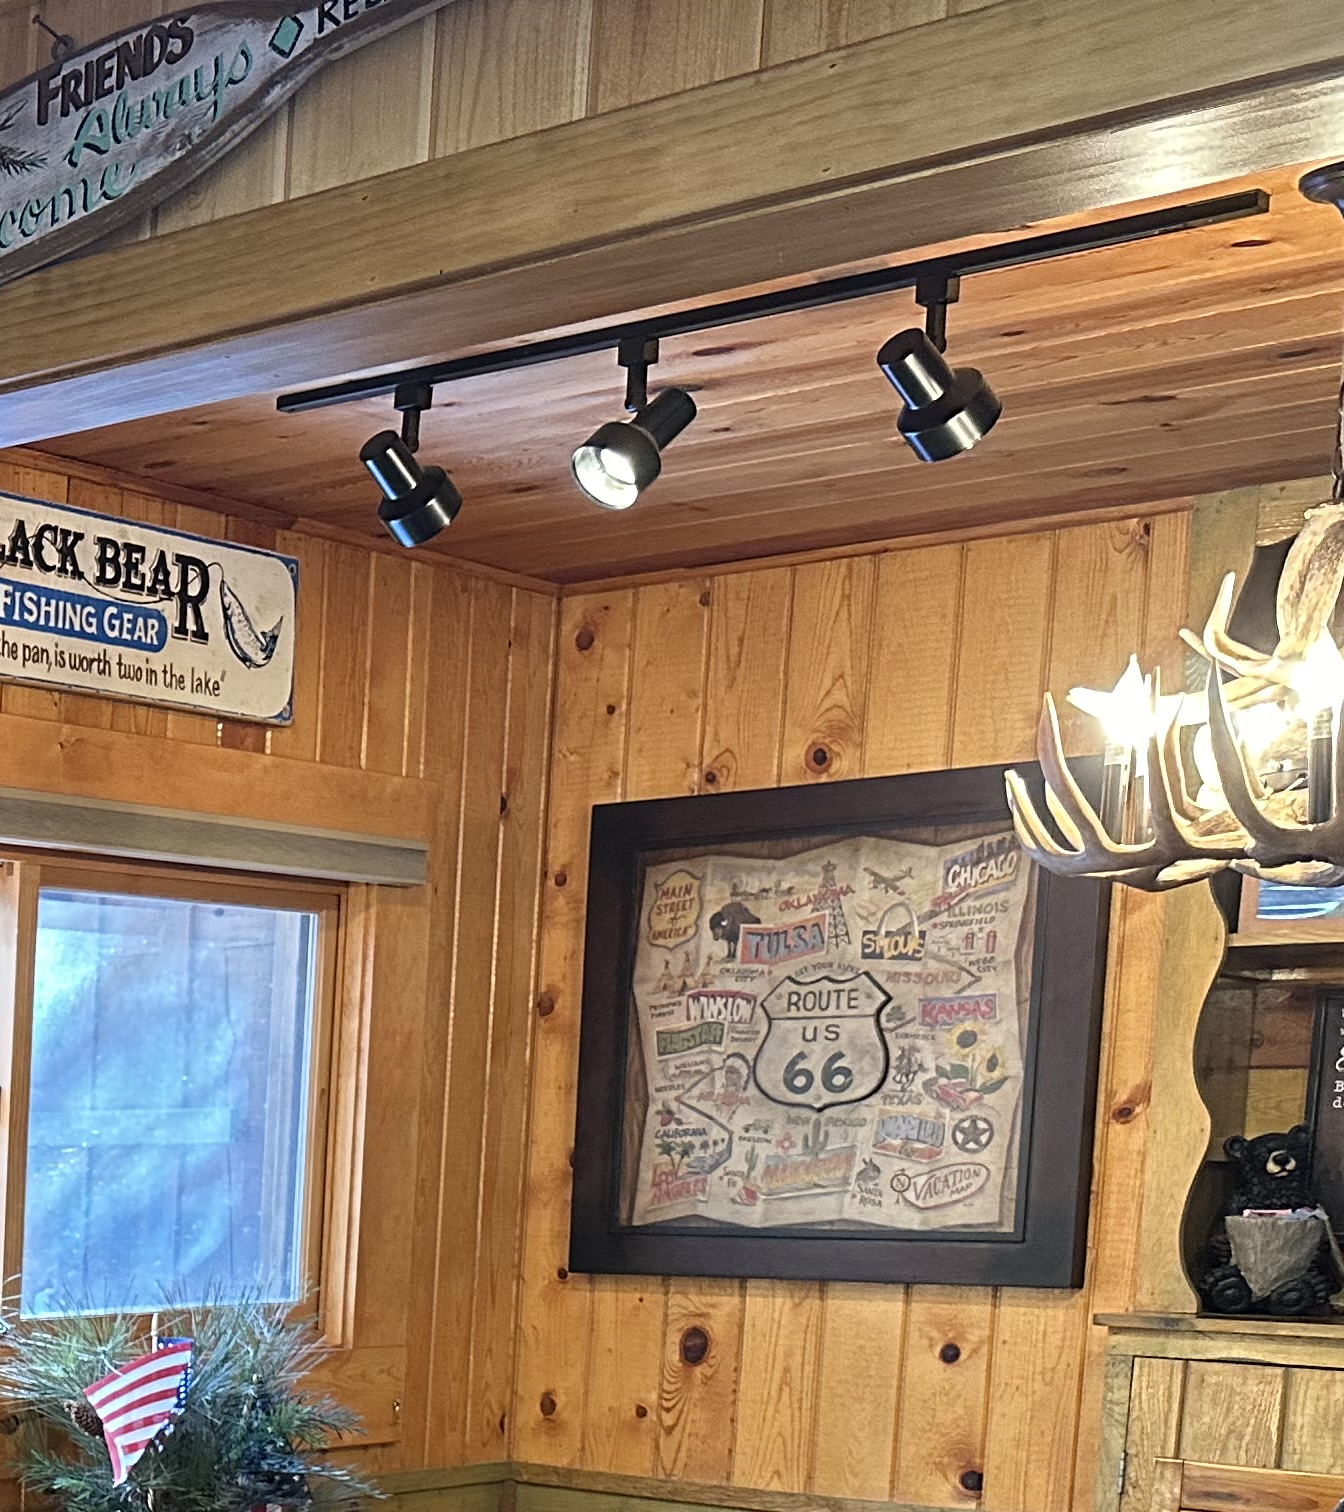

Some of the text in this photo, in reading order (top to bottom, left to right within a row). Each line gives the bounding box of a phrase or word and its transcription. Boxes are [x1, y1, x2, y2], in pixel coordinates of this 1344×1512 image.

[37, 17, 196, 126] FRIENDS
[65, 39, 253, 168] Always
[94, 535, 209, 644] BEAR
[103, 606, 160, 645] GEAR
[23, 643, 52, 673] pan,
[55, 643, 66, 668] is
[69, 649, 111, 677] worth
[116, 654, 142, 682] two
[145, 658, 158, 686] in
[162, 663, 185, 691] the
[947, 851, 1017, 889] CHICAGO
[659, 883, 693, 900] MAIN
[779, 884, 855, 912] OKLAHOMA
[655, 897, 695, 916] STREET
[947, 900, 1009, 919] ILLINOIS
[938, 916, 996, 930] SPRINGFIELD
[746, 922, 825, 959] TULSA
[811, 961, 835, 971] YOUR
[885, 970, 961, 984] MISSOURI
[976, 965, 997, 973] CITY
[688, 996, 753, 1022] WINSLOW
[787, 988, 859, 1012] ROUTE
[920, 998, 994, 1025] KANSAS
[802, 1023, 841, 1042] US
[783, 1050, 854, 1094] 66
[880, 1092, 923, 1106] TEXAS
[655, 1126, 708, 1139] CALIFORNIA
[913, 1167, 982, 1201] VACATION
[949, 1183, 973, 1197] MAP
